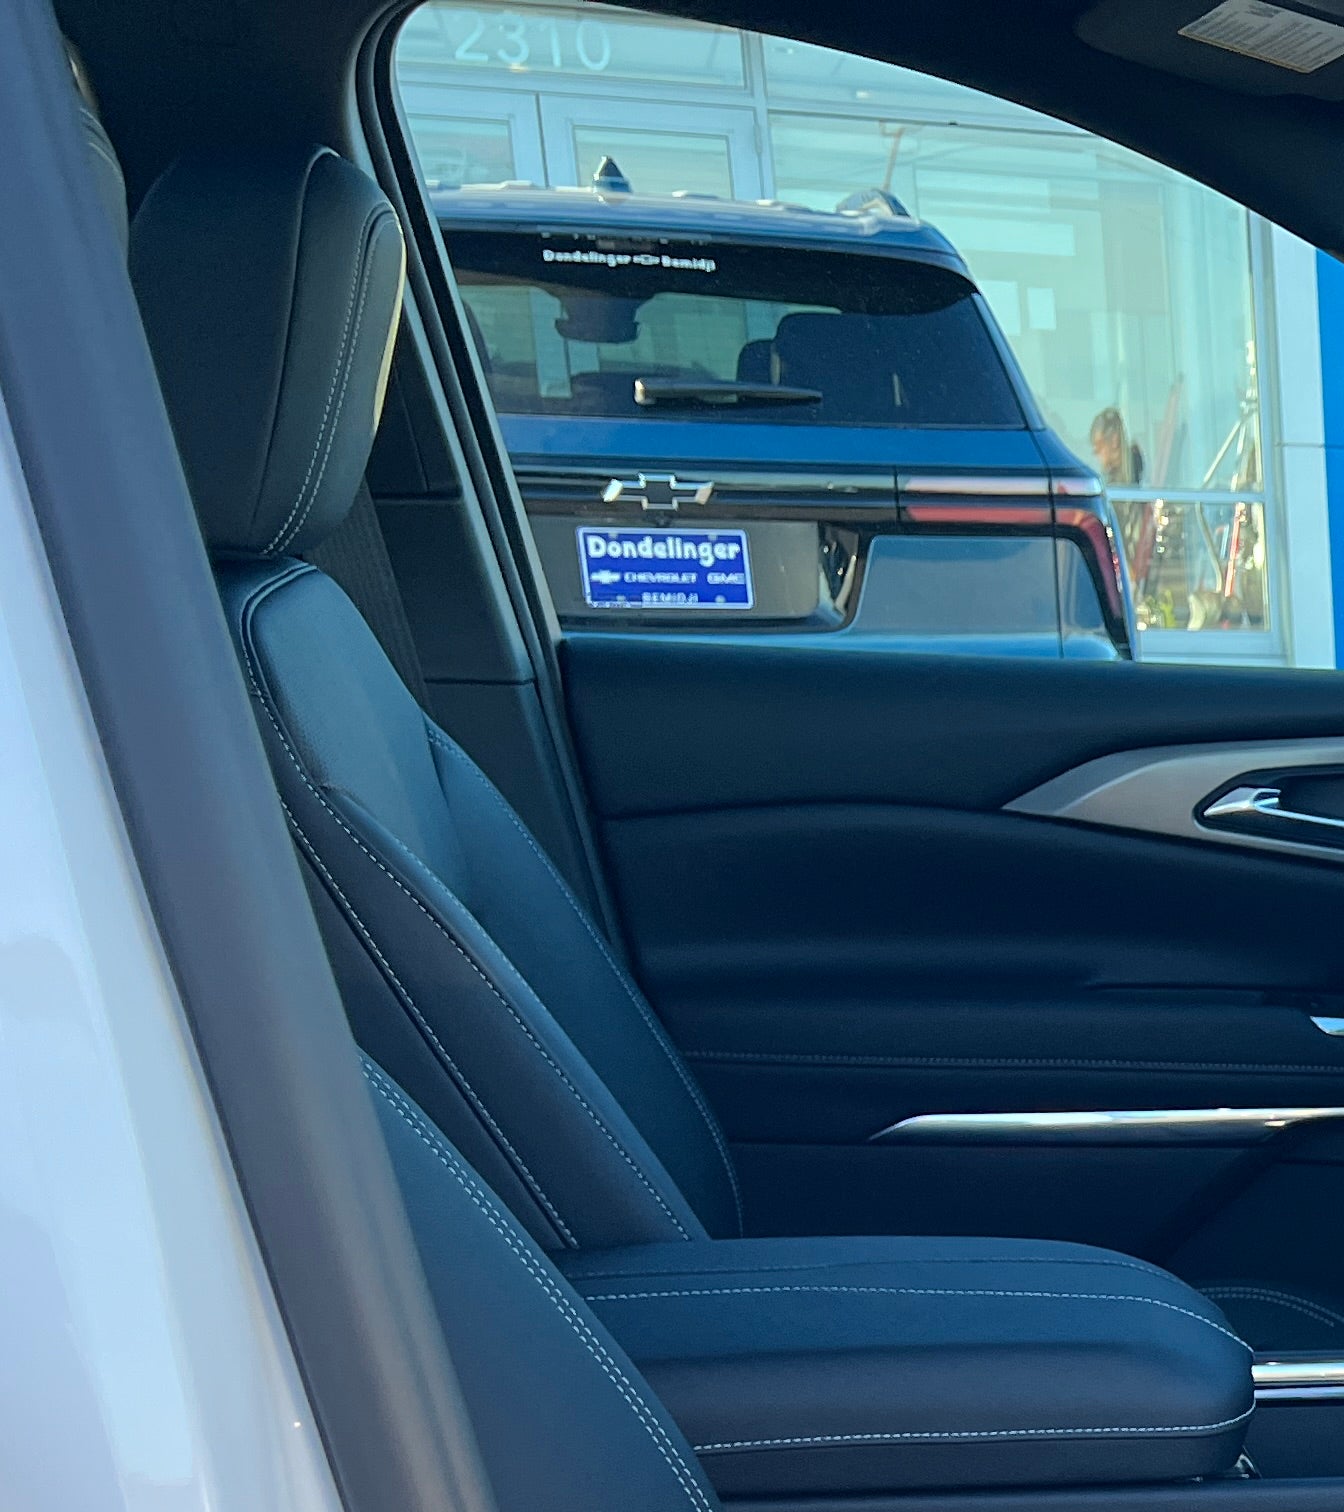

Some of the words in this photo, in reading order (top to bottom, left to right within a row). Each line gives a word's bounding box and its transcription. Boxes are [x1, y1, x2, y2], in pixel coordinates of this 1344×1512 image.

[455, 10, 611, 71] 2310
[586, 534, 741, 567] Dondelinger
[623, 571, 697, 584] CHEVROLET
